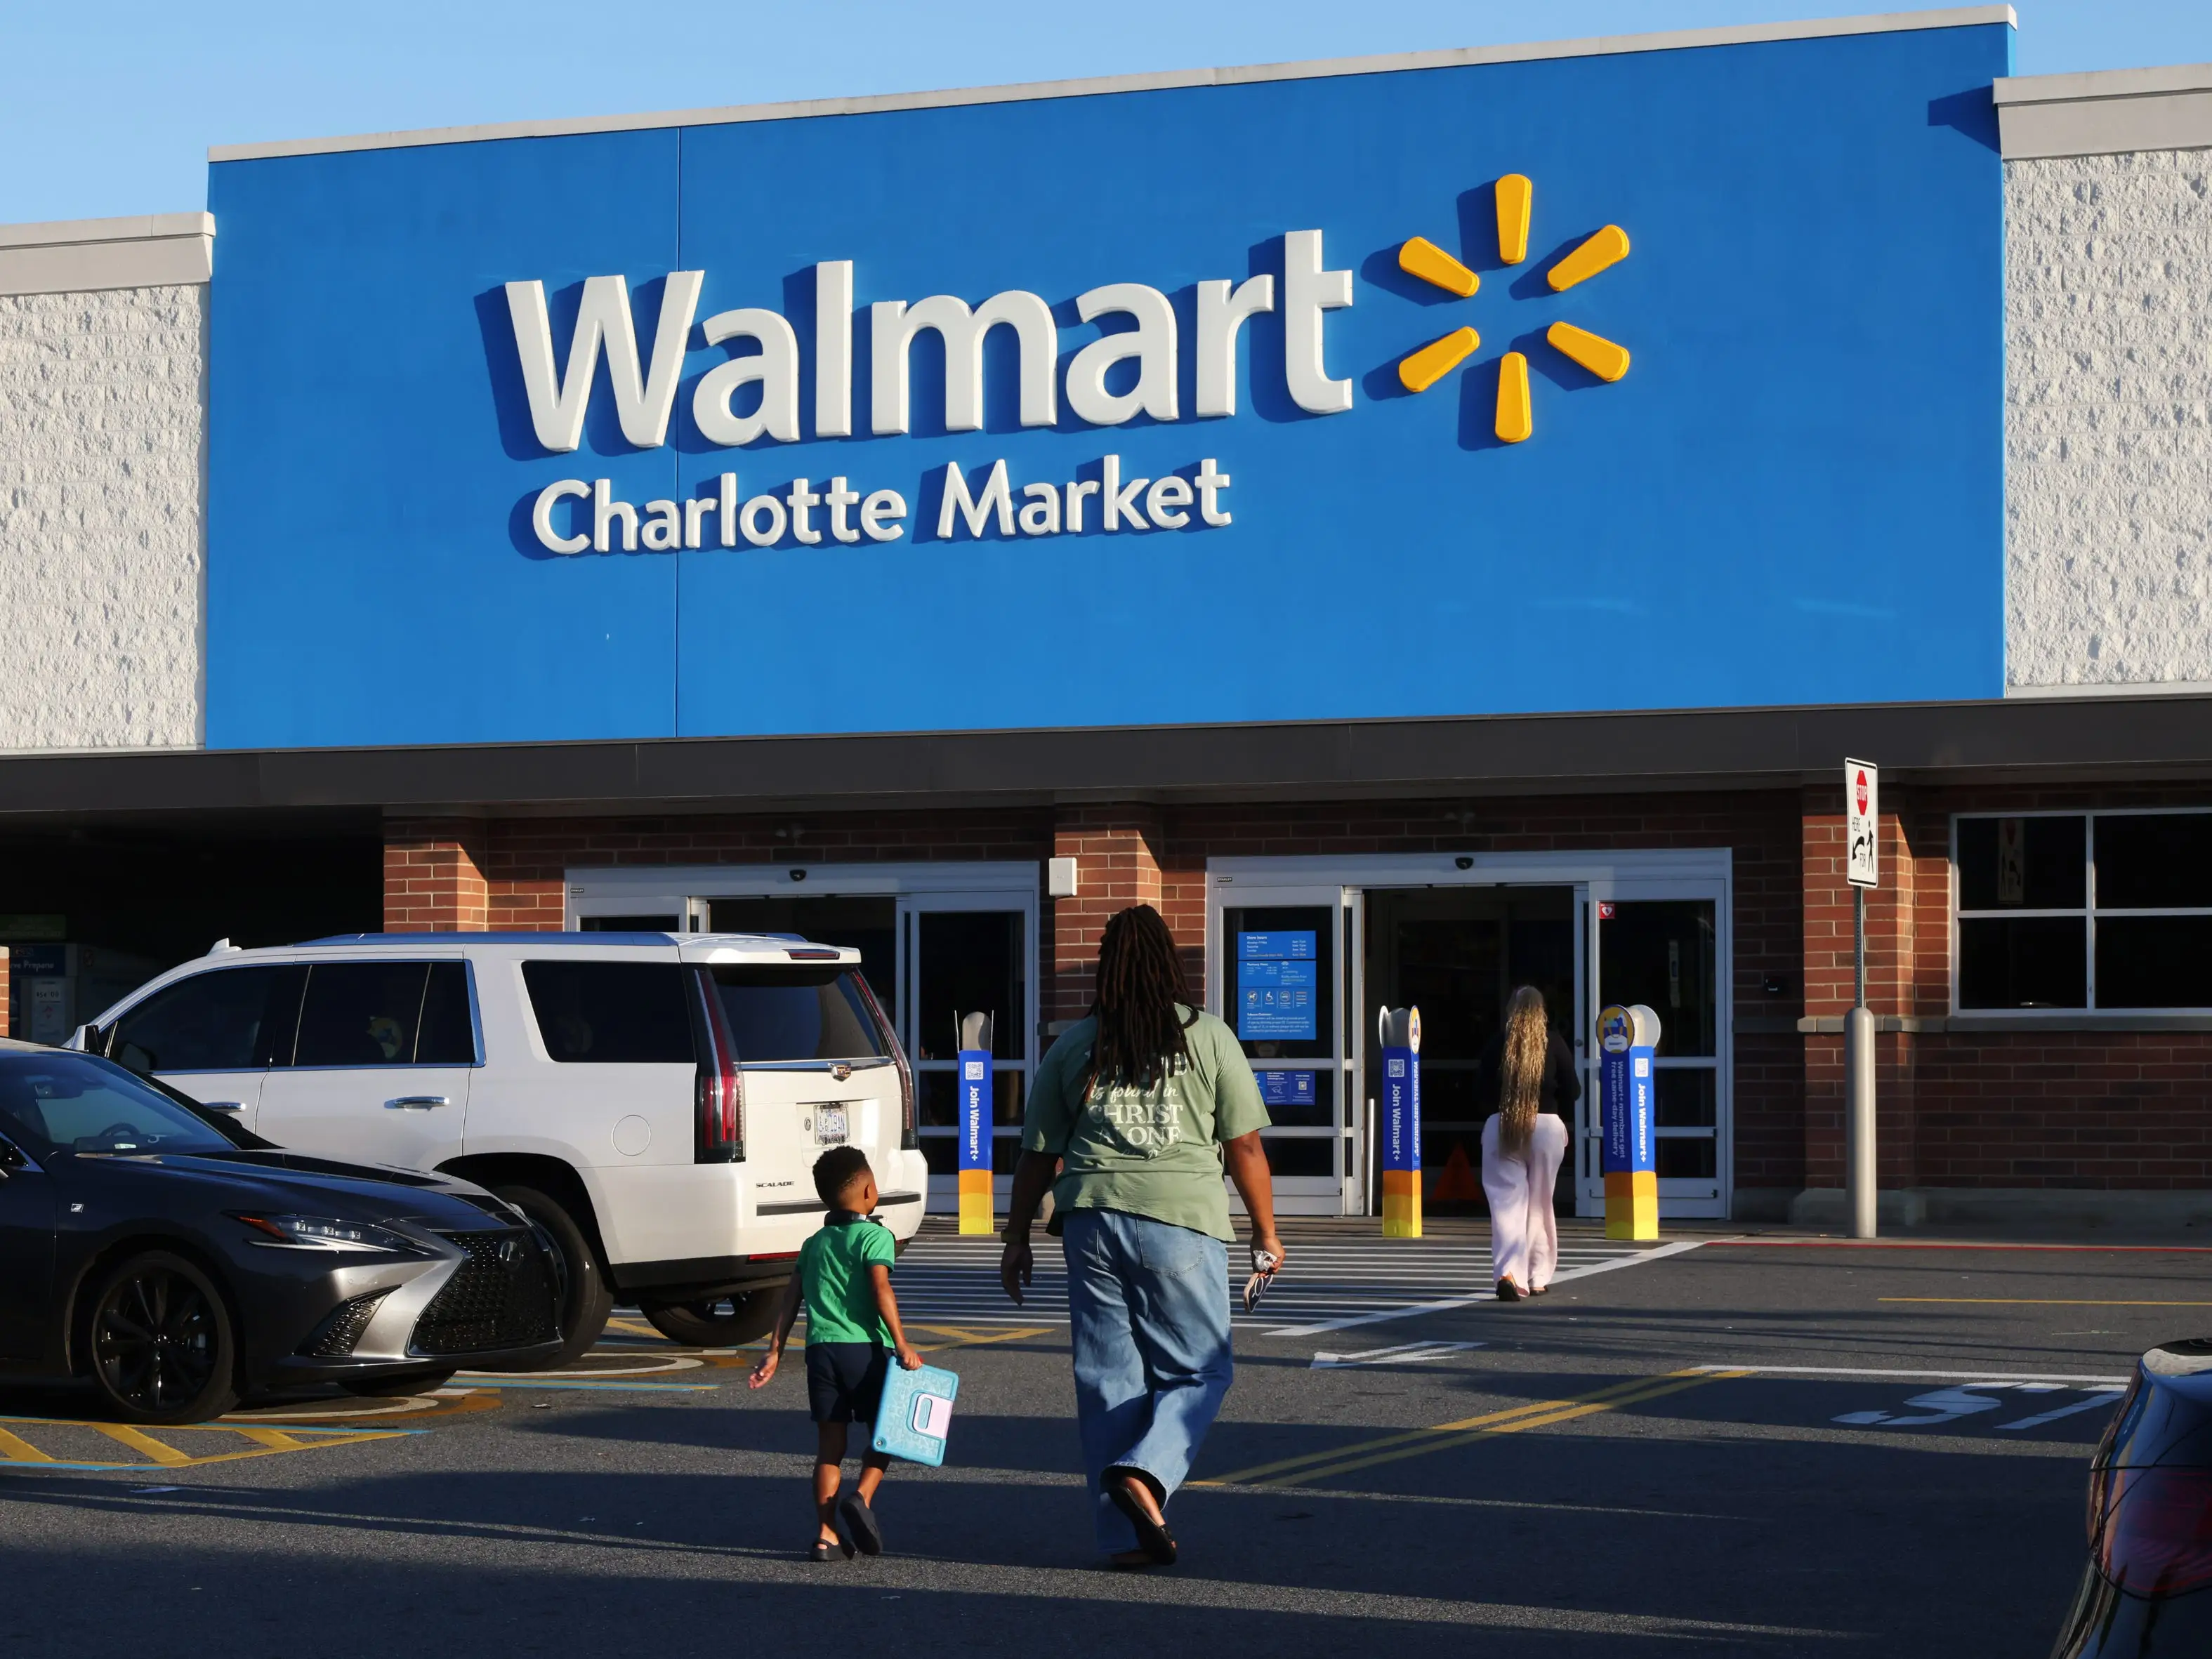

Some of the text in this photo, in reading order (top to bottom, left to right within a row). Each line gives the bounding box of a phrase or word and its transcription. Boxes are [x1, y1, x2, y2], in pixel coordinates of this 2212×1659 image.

[504, 229, 1353, 452] Walmart
[532, 454, 1232, 555] Charlotte Market
[1857, 784, 1867, 802] STOP
[970, 1085, 980, 1161] Join Walmart+
[1088, 1104, 1183, 1124] CHRIST
[1090, 1084, 1104, 1100] is
[1163, 1084, 1179, 1098] in
[1393, 1083, 1402, 1161] Join Walmart+
[1638, 1083, 1647, 1163] Join Walmart+
[1095, 1125, 1183, 1146] AONE
[1830, 1381, 2131, 1430] ST
